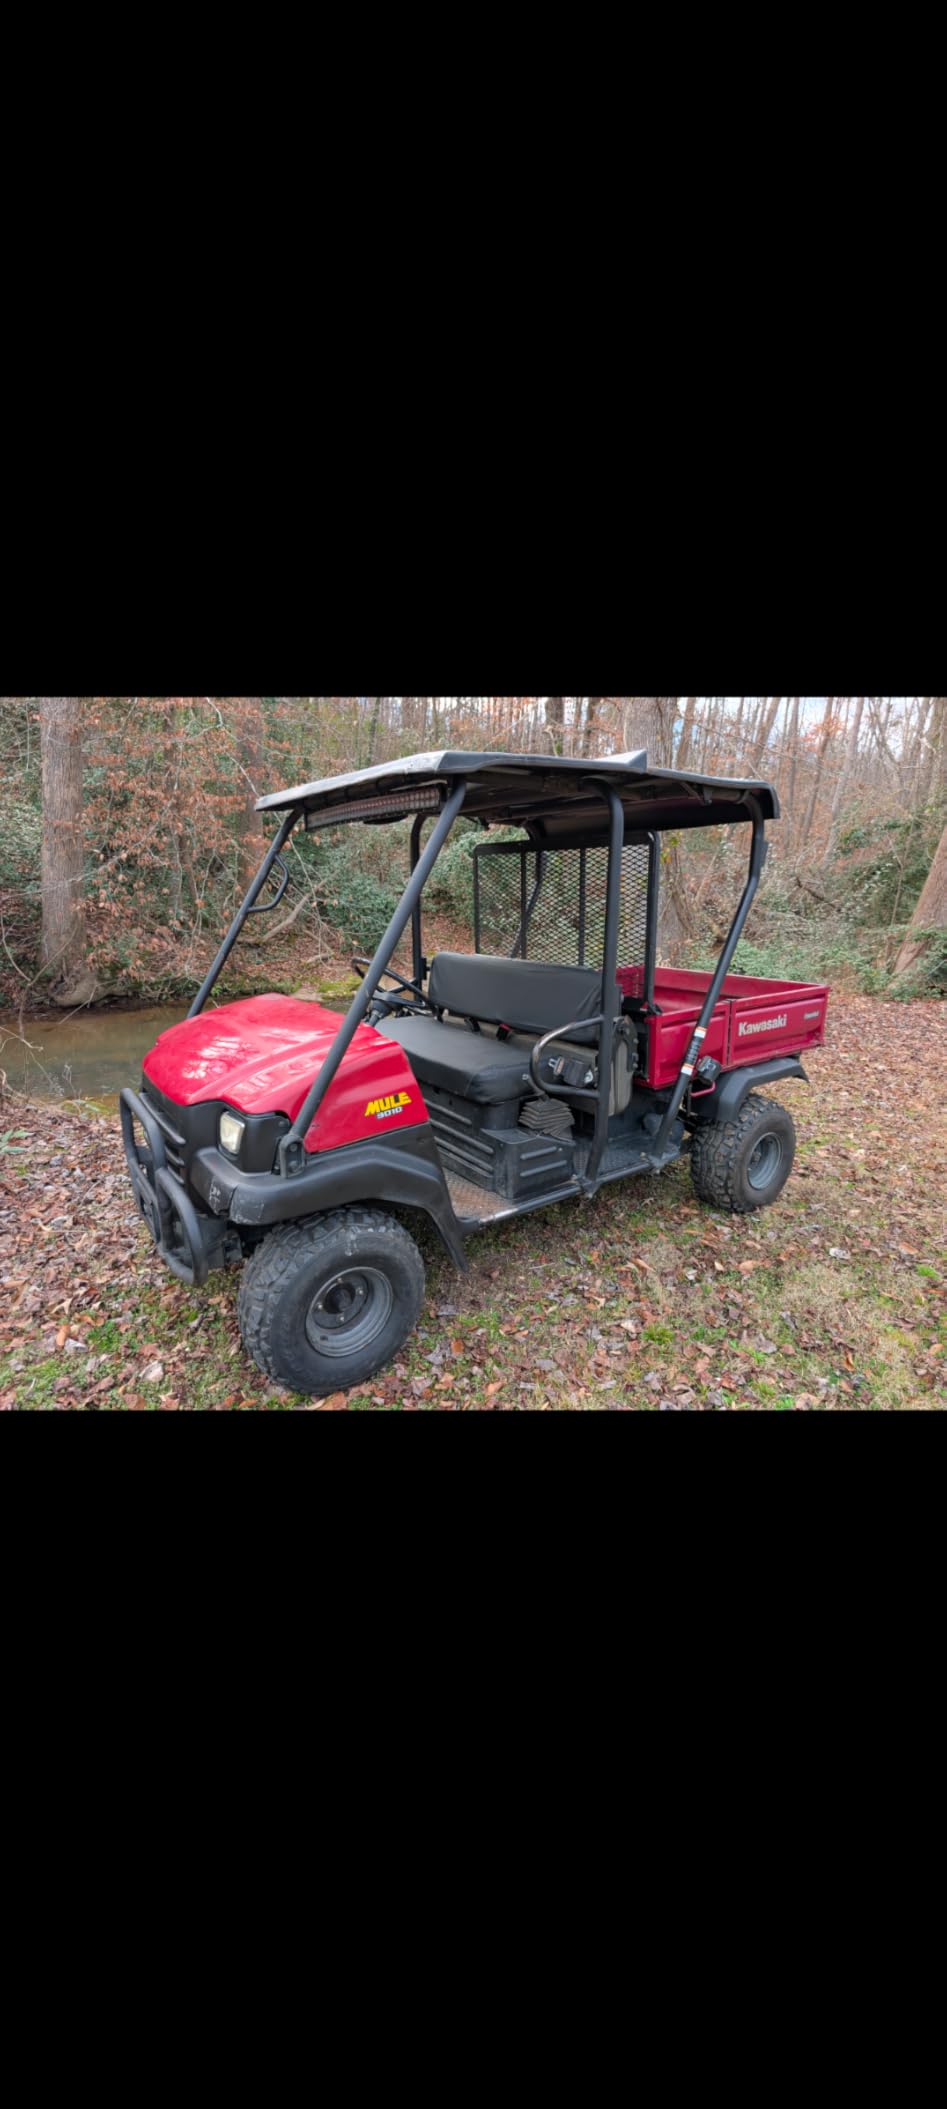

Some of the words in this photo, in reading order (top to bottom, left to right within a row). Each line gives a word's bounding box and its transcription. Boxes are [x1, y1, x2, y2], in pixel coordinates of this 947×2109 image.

[738, 1014, 787, 1036] Kawasaki
[364, 1092, 412, 1117] MULE
[376, 1106, 403, 1119] 3010
